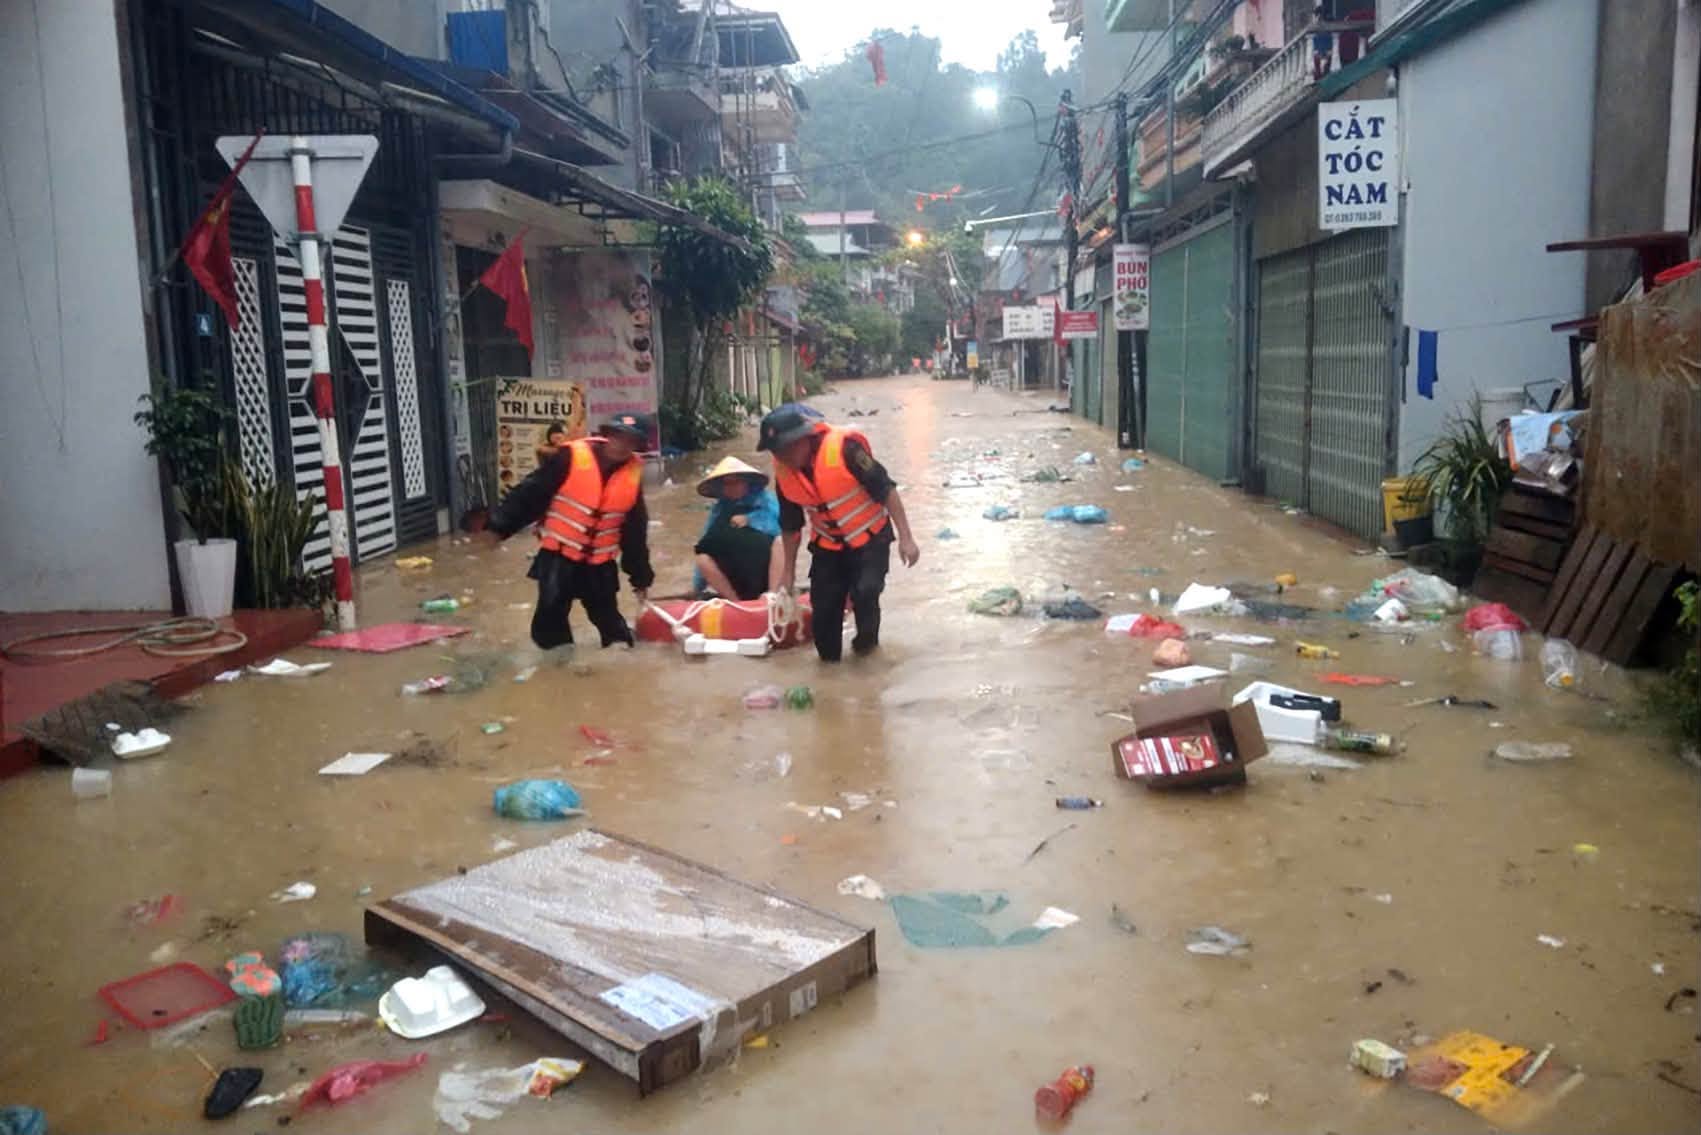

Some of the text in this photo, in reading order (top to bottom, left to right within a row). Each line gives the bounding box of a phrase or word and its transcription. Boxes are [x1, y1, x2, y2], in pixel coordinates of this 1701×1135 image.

[1325, 105, 1385, 140] CẮT
[1325, 145, 1384, 174] TÓC
[1326, 182, 1387, 206] NAM
